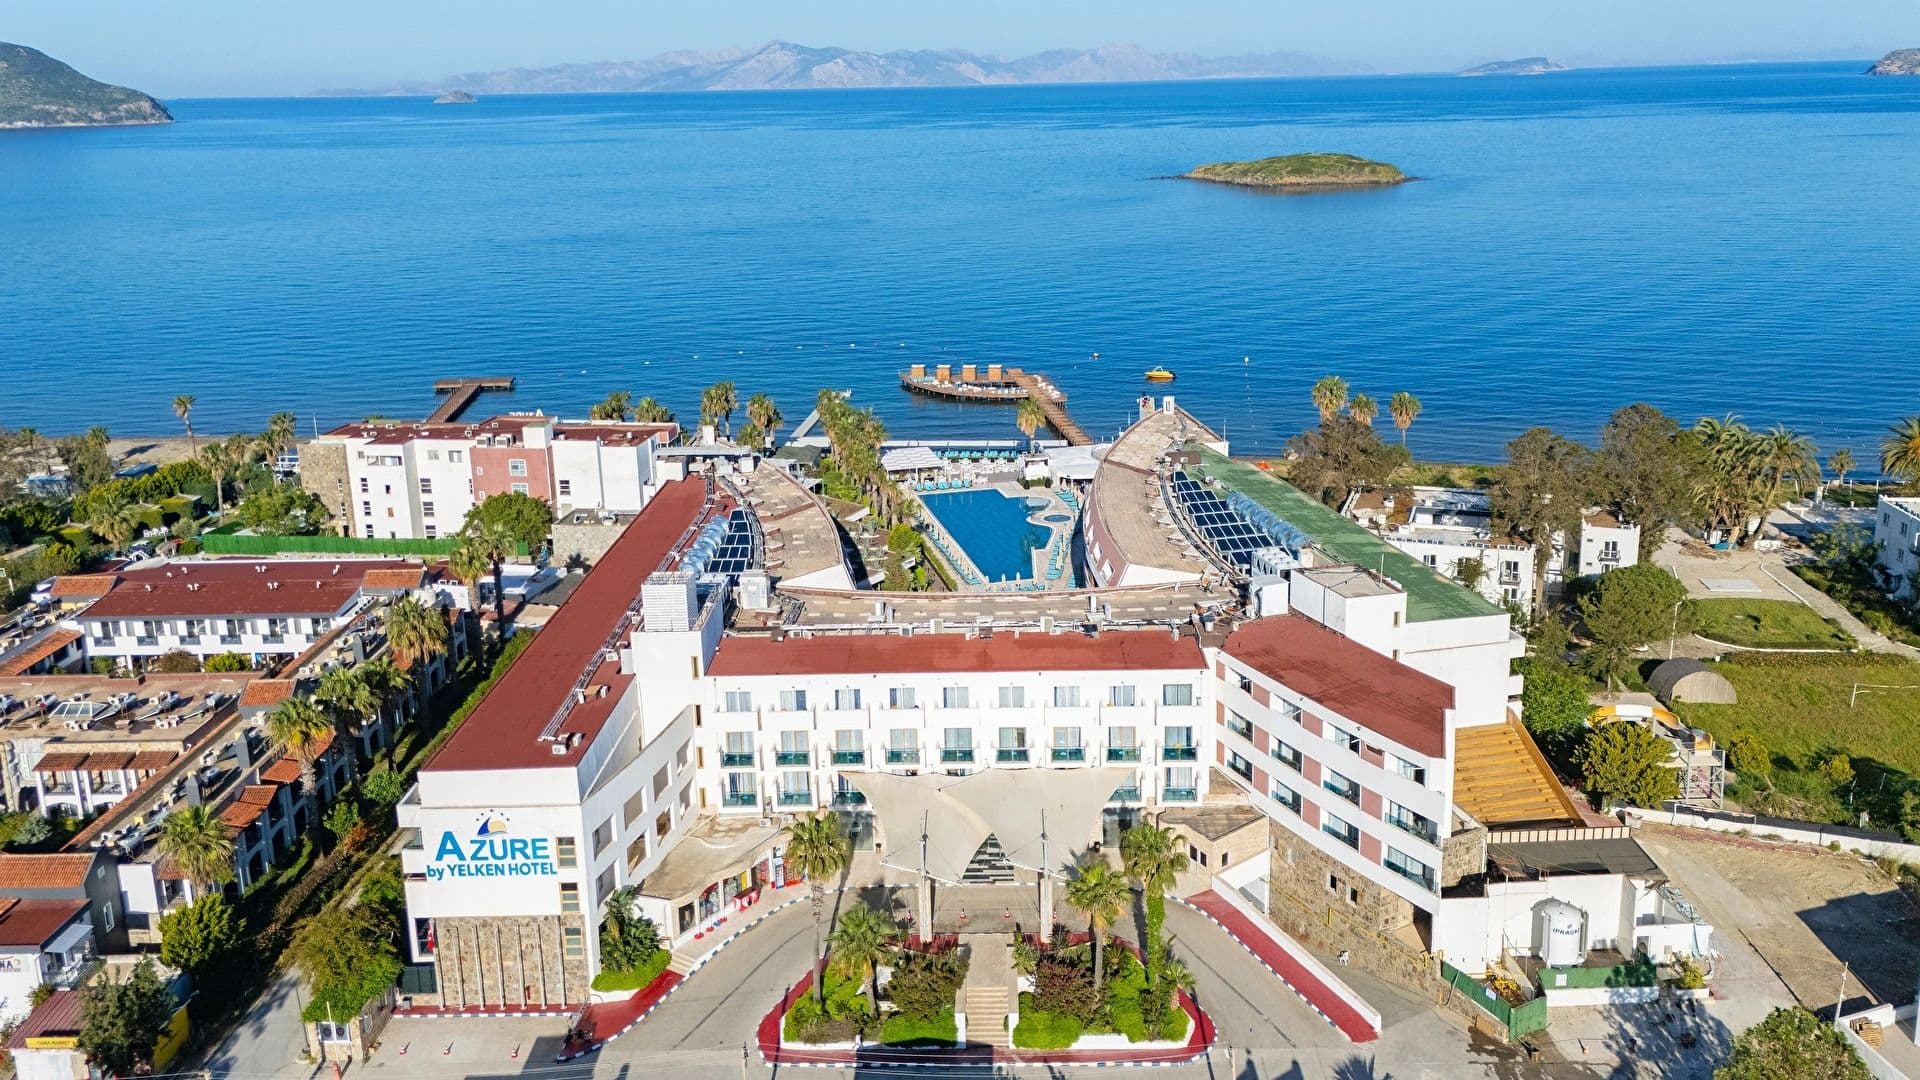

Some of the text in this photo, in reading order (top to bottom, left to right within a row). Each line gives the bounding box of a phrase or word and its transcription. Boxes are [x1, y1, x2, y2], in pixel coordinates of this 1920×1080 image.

[435, 830, 550, 862] AZURE
[426, 862, 558, 881] by YELKEN HOTEL
